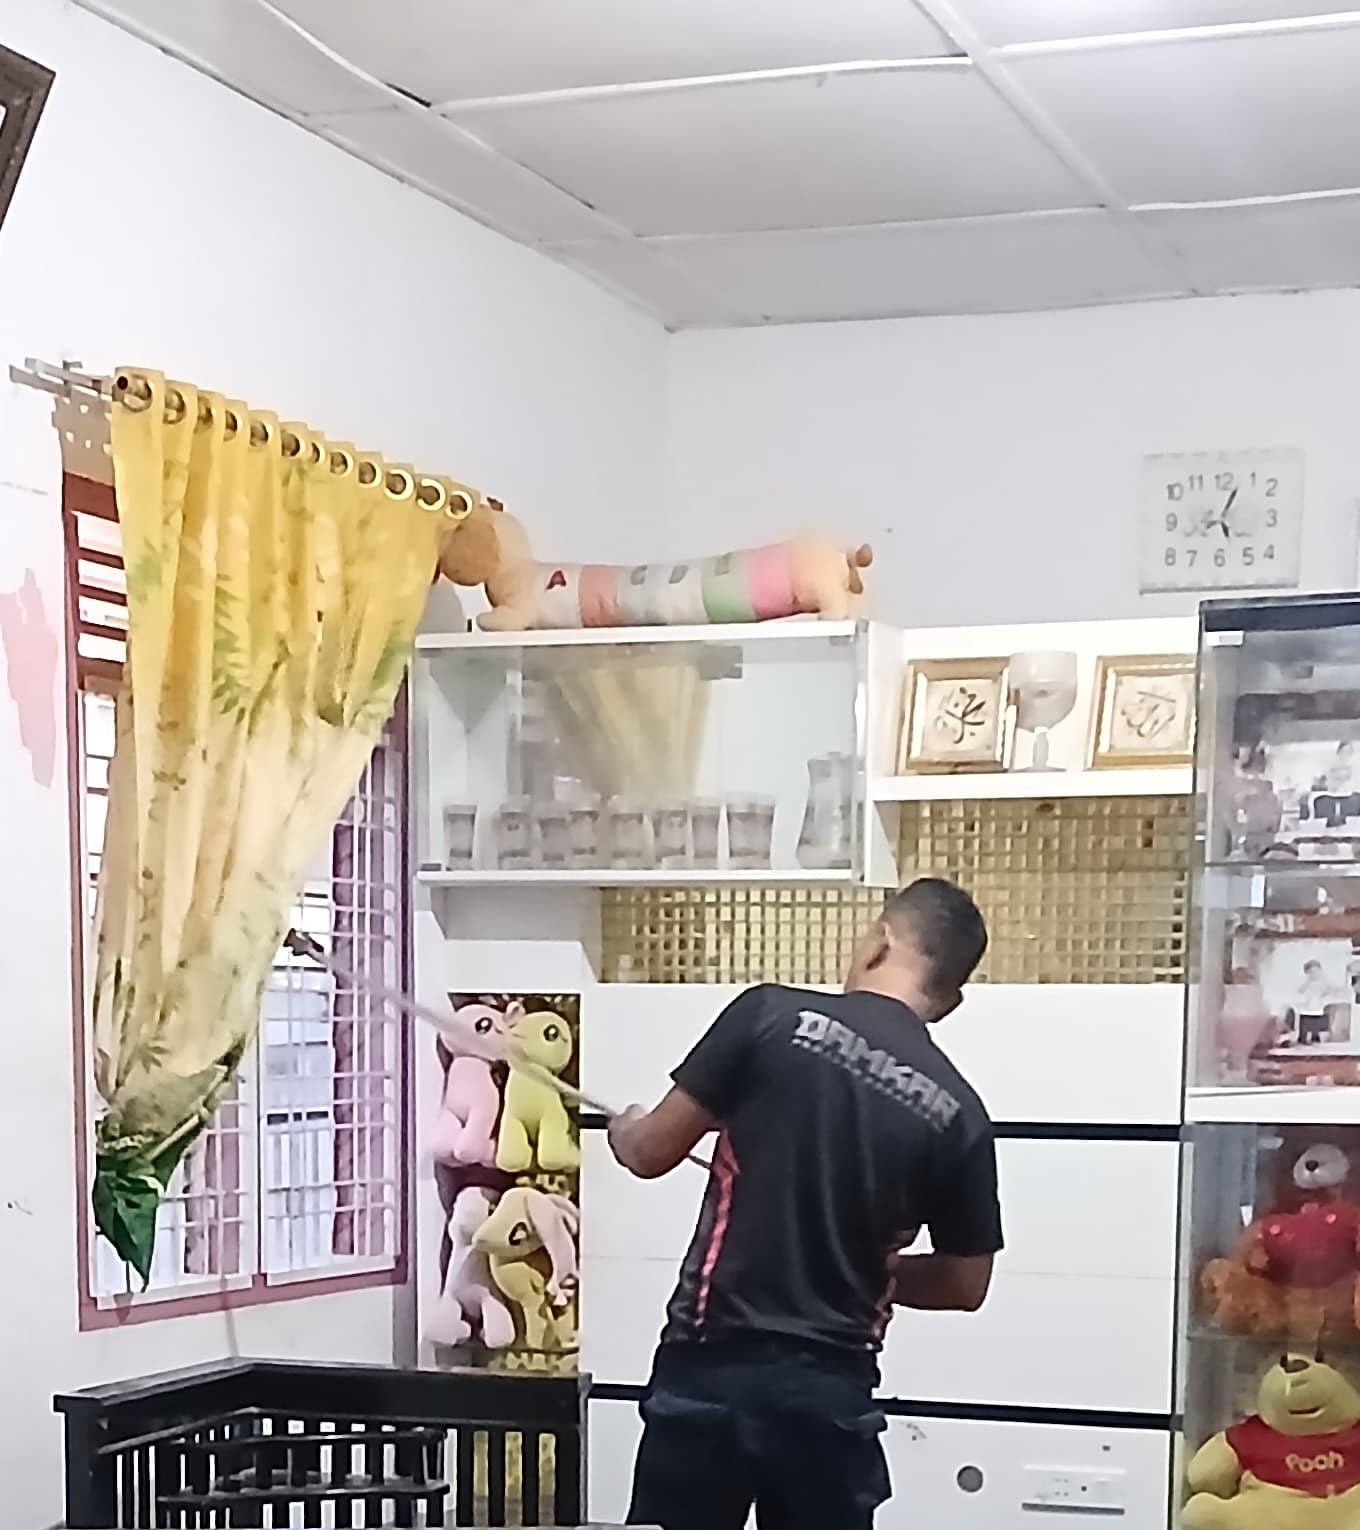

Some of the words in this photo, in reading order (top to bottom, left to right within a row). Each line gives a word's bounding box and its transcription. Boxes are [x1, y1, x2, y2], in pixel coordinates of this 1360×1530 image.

[1166, 482, 1184, 501] 10
[1188, 474, 1204, 491] 11
[1214, 471, 1234, 491] 12
[1250, 471, 1256, 488] 1
[1265, 477, 1278, 497] 2
[1165, 512, 1178, 532] 9
[1265, 507, 1278, 527] 3
[1164, 546, 1177, 566] 8
[1186, 549, 1198, 568] 7
[1213, 547, 1226, 567] 6
[1242, 546, 1255, 566] 5
[1263, 543, 1275, 560] 4
[794, 1009, 961, 1130] DAMKAR
[1285, 1450, 1344, 1473] Pooh
